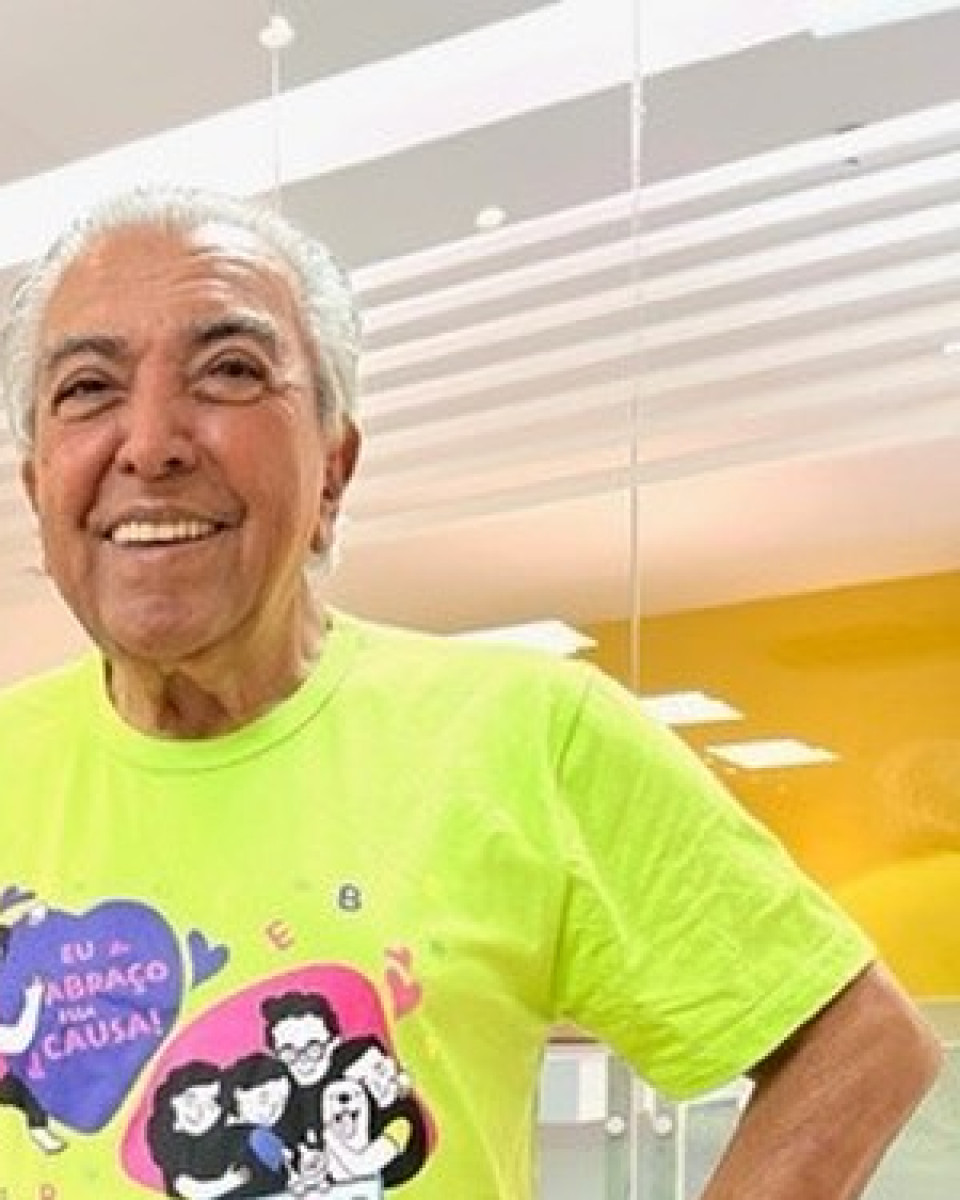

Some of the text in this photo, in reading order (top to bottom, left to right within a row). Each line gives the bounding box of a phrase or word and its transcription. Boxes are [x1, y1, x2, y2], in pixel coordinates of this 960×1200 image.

[60, 940, 94, 964] EU
[45, 959, 169, 1006] ABRAÇO
[44, 1008, 163, 1060] CAUSA!
